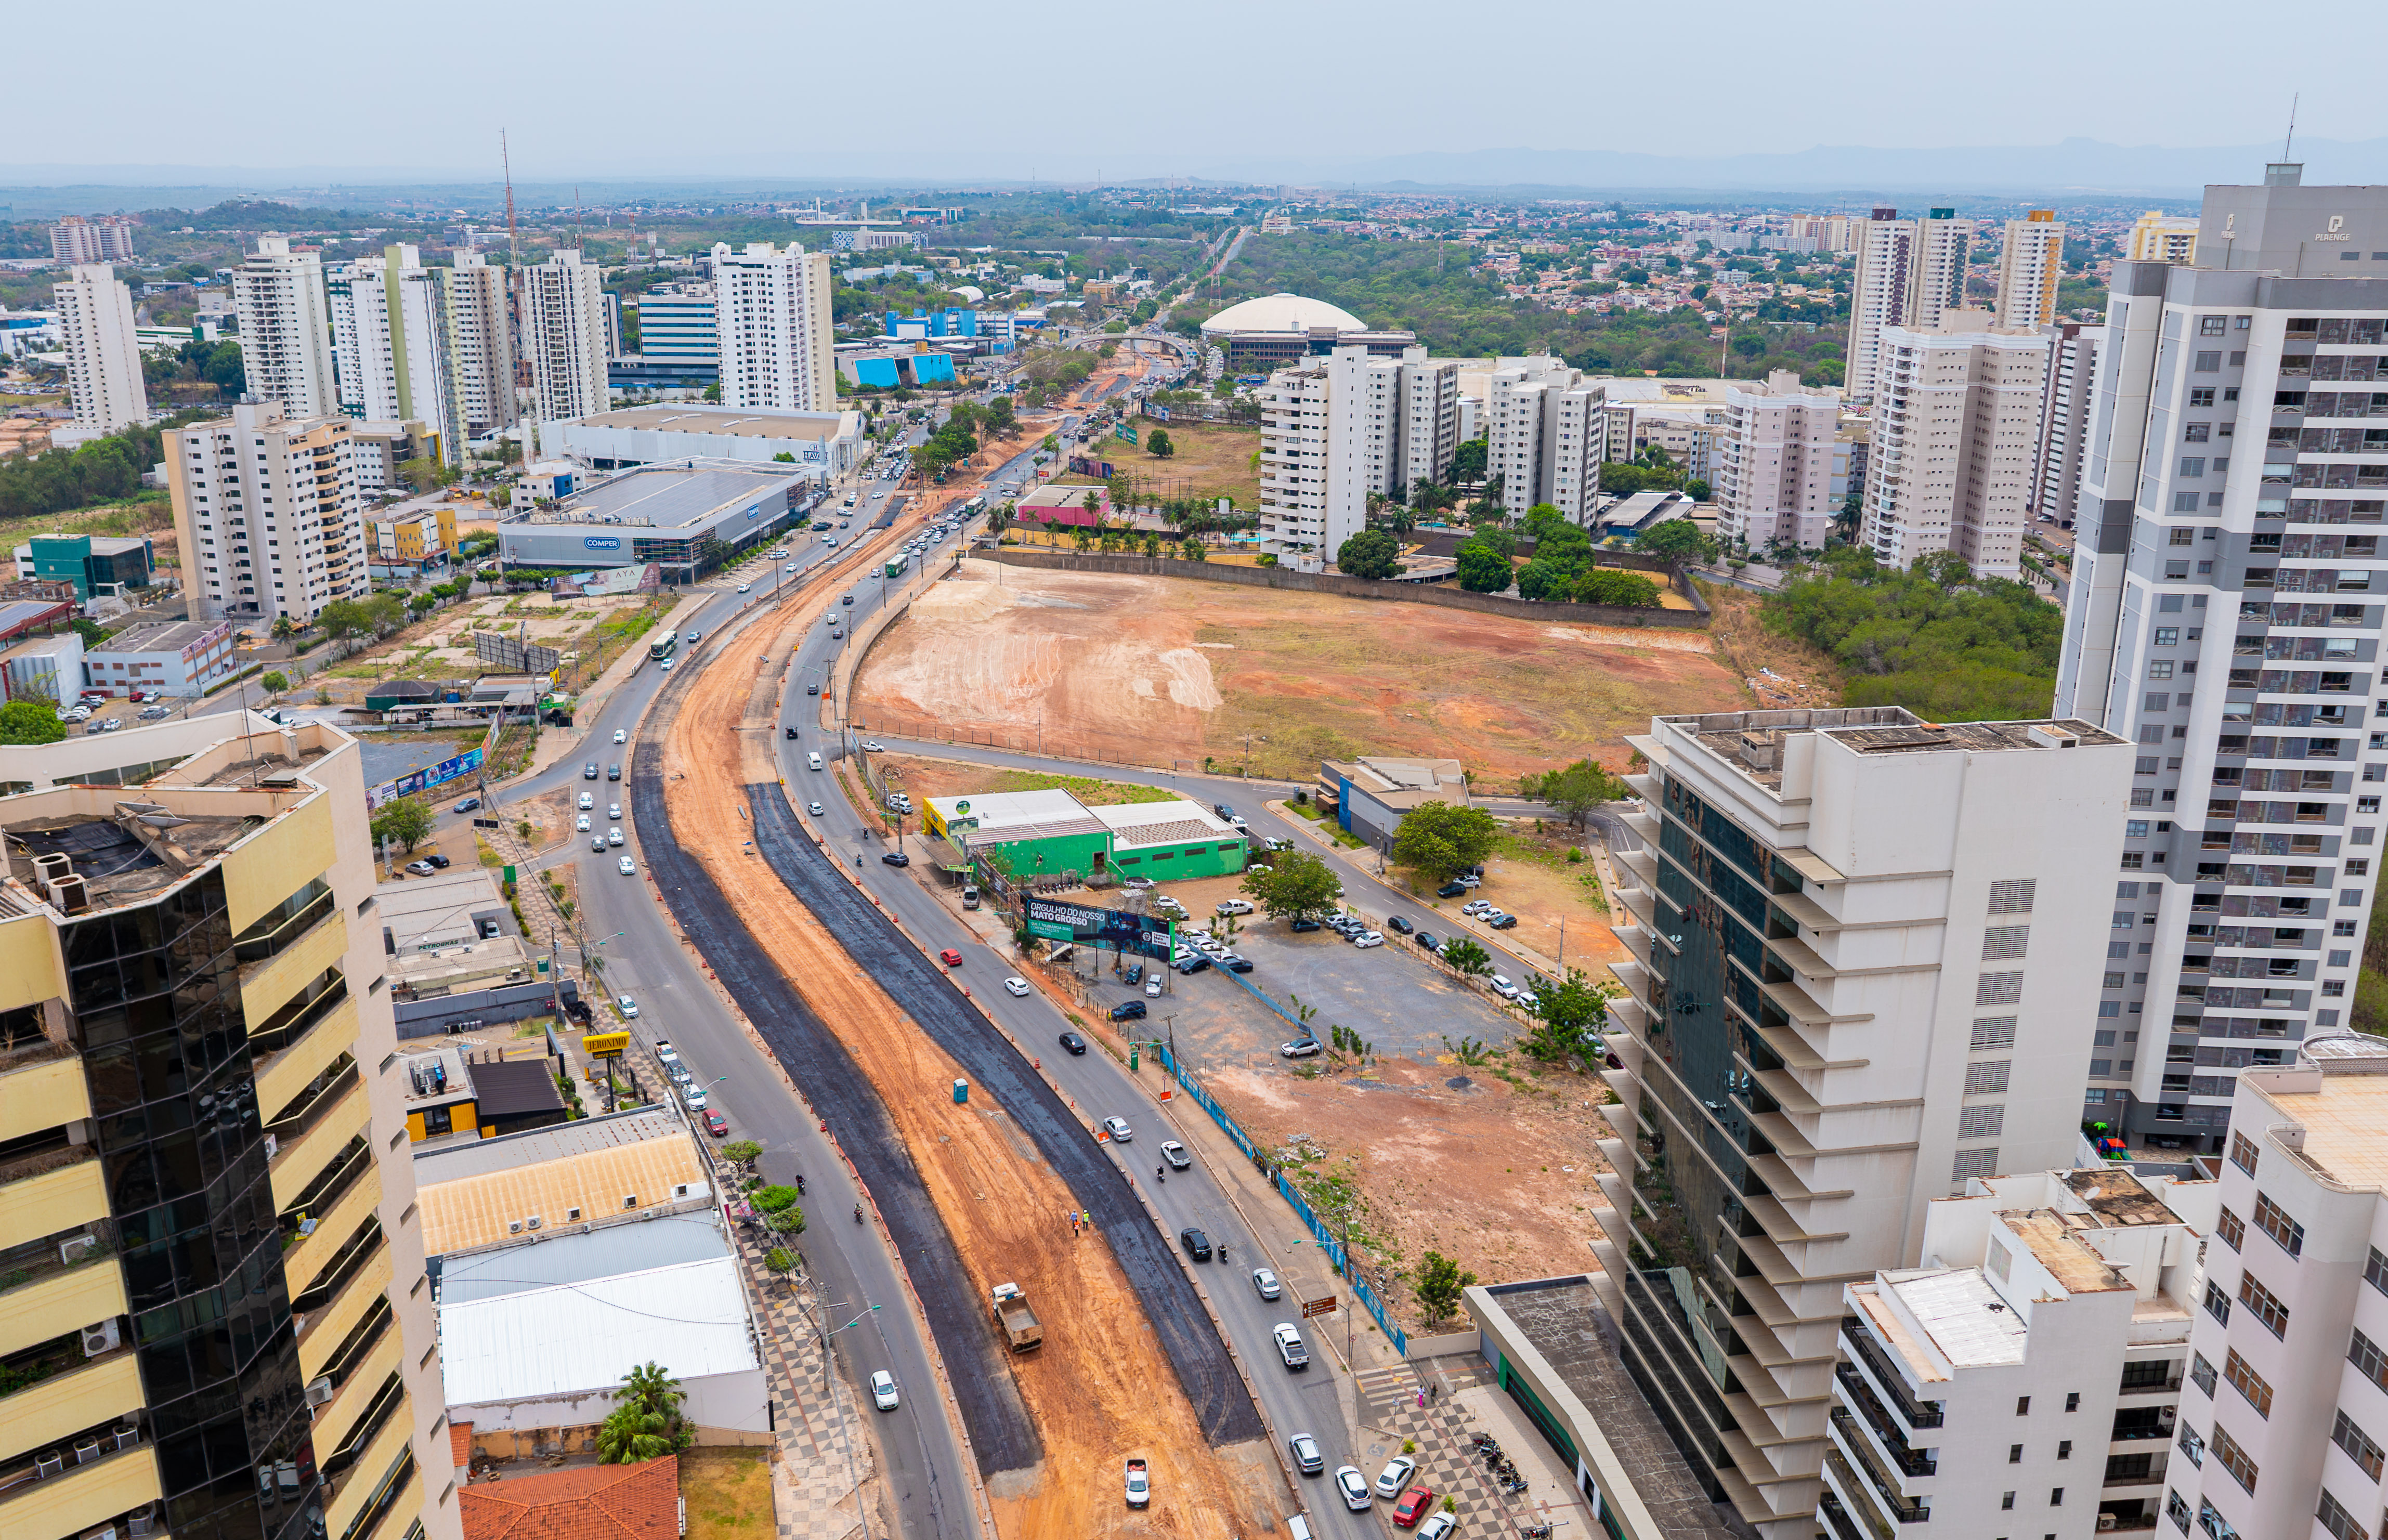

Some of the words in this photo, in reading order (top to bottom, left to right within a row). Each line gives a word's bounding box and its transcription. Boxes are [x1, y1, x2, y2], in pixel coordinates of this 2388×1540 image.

[803, 451, 828, 460] HAV
[616, 570, 635, 578] AYA
[1030, 902, 1066, 915] ORGULHO
[1067, 908, 1078, 917] DO
[1079, 910, 1105, 921] NOSSO
[1030, 910, 1054, 922] MATO
[1055, 914, 1088, 926] GROSSO
[418, 939, 459, 950] PETROBRAS
[588, 1037, 626, 1051] JERONIMO
